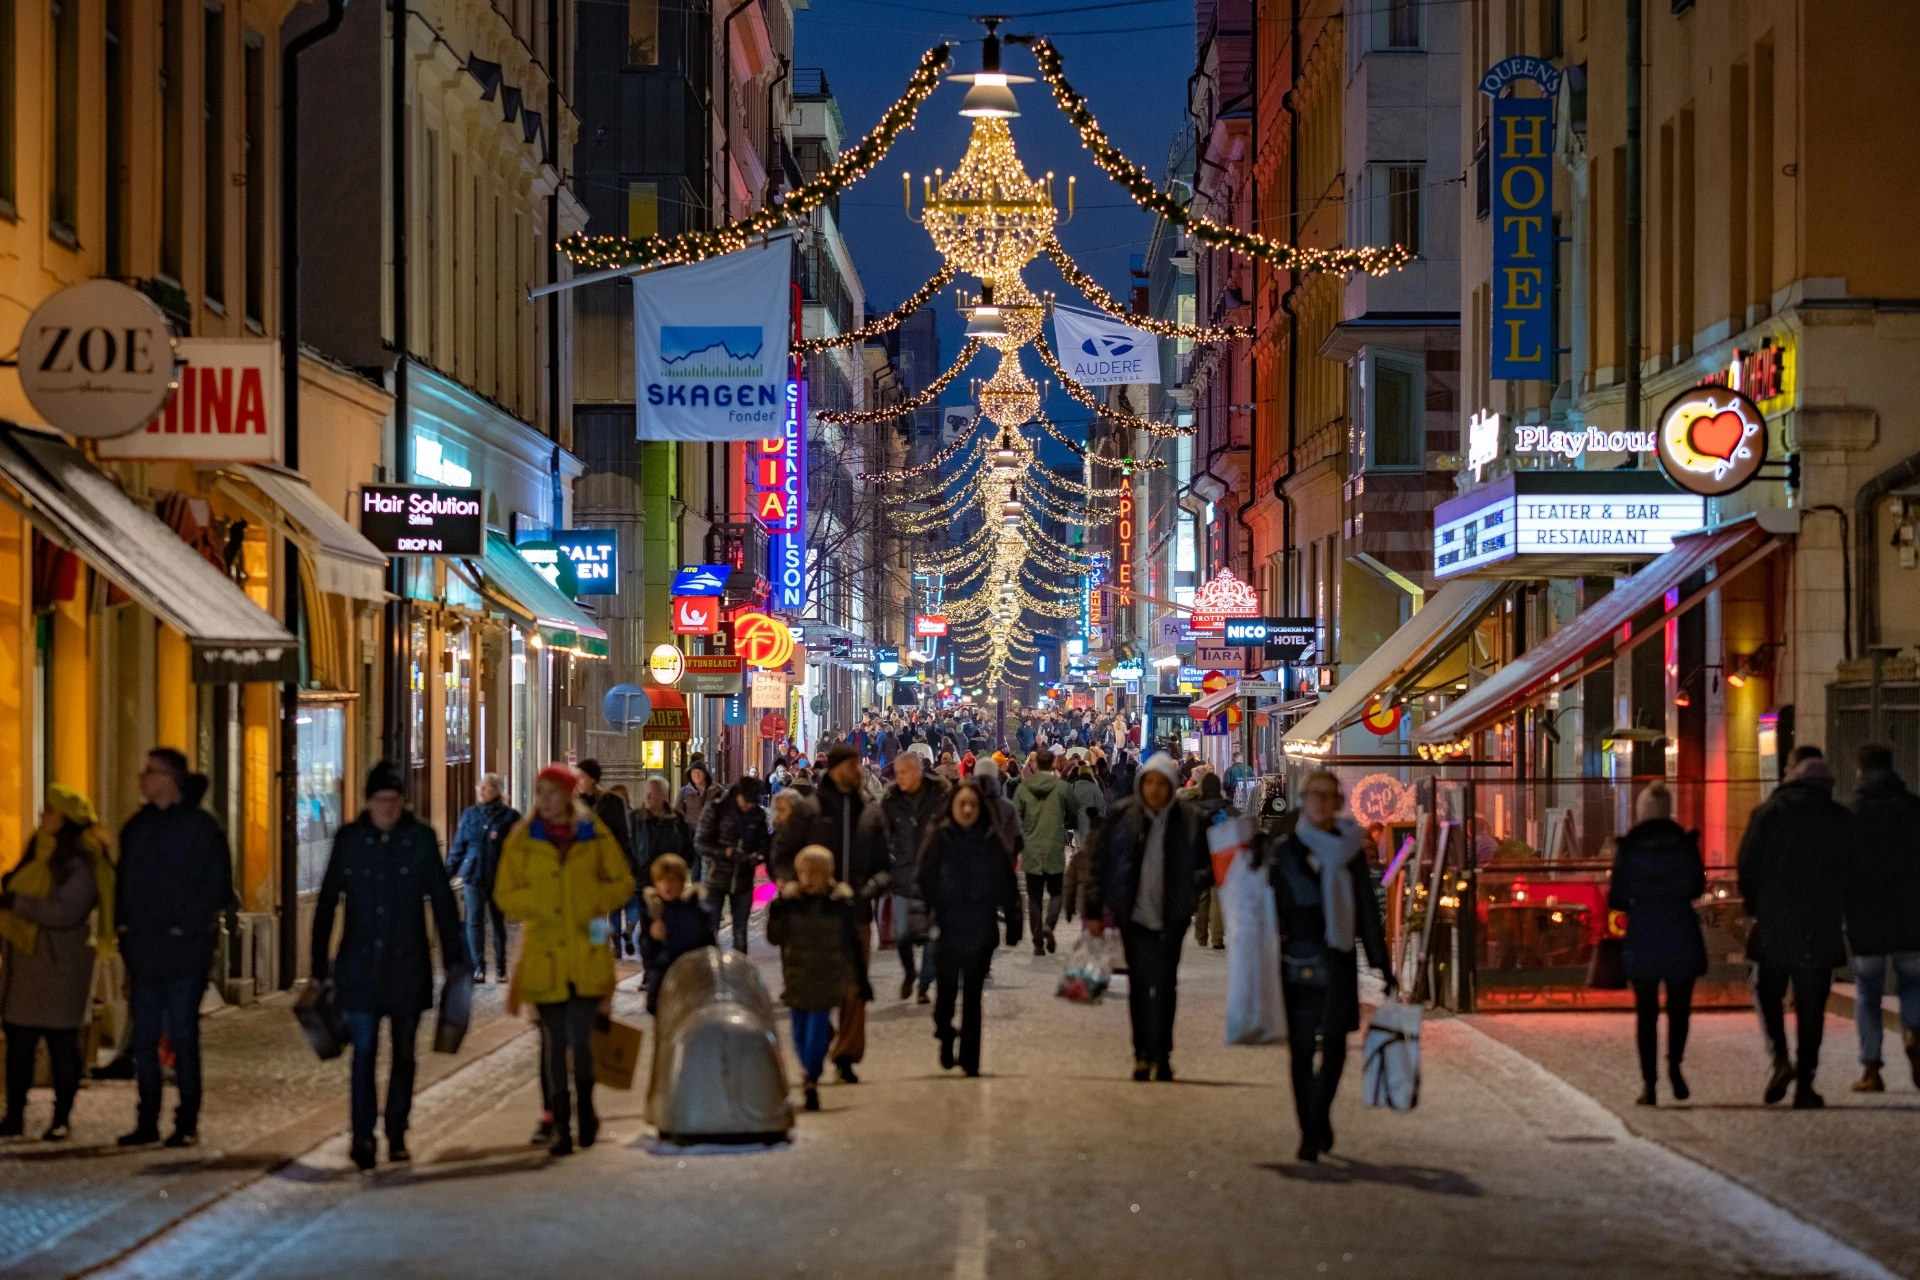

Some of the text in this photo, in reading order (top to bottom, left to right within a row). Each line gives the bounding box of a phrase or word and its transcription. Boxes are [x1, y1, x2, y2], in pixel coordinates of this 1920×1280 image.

[1484, 58, 1559, 92] QUEEN'S
[1499, 115, 1548, 363] HOTEL
[38, 326, 154, 374] ZOE
[1075, 359, 1143, 375] AUDERE
[647, 383, 777, 406] SKAGEN
[728, 409, 777, 422] fonder
[364, 492, 479, 515] Hair Solution
[1527, 504, 1660, 519] TEATER & BAR
[397, 538, 443, 552] DROP IN
[1119, 478, 1132, 606] APOTEK
[1536, 529, 1648, 545] RESTAURANT
[1227, 625, 1266, 638] NICO
[1273, 635, 1307, 645] HOTEL
[684, 659, 738, 668] AFTONBLADET
[756, 675, 783, 683] CITY
